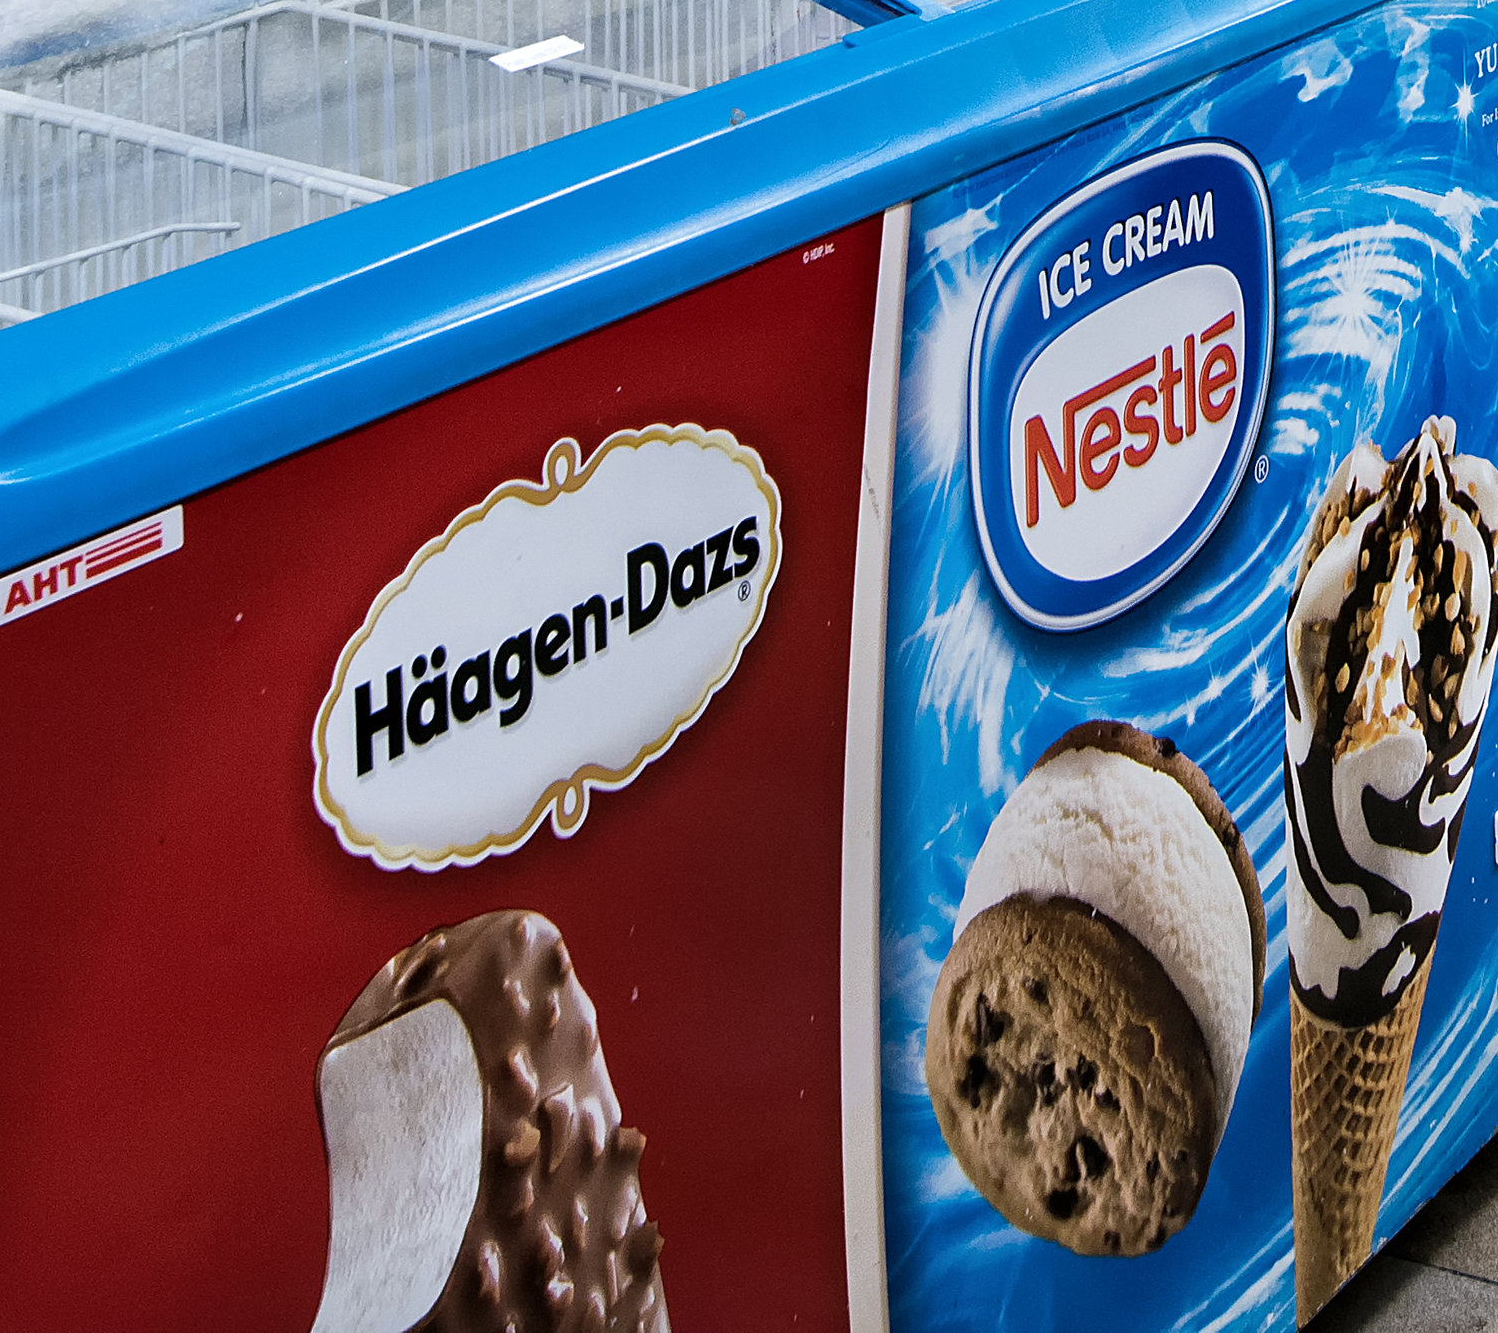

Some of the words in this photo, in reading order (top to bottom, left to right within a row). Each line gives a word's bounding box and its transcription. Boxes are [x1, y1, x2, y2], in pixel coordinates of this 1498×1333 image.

[1481, 113, 1493, 127] For
[1038, 241, 1092, 319] ICE
[1103, 191, 1214, 277] CREAM
[1025, 311, 1237, 528] Nestlé
[3, 552, 88, 617] AHT
[353, 515, 759, 778] Häagen-Dazs
